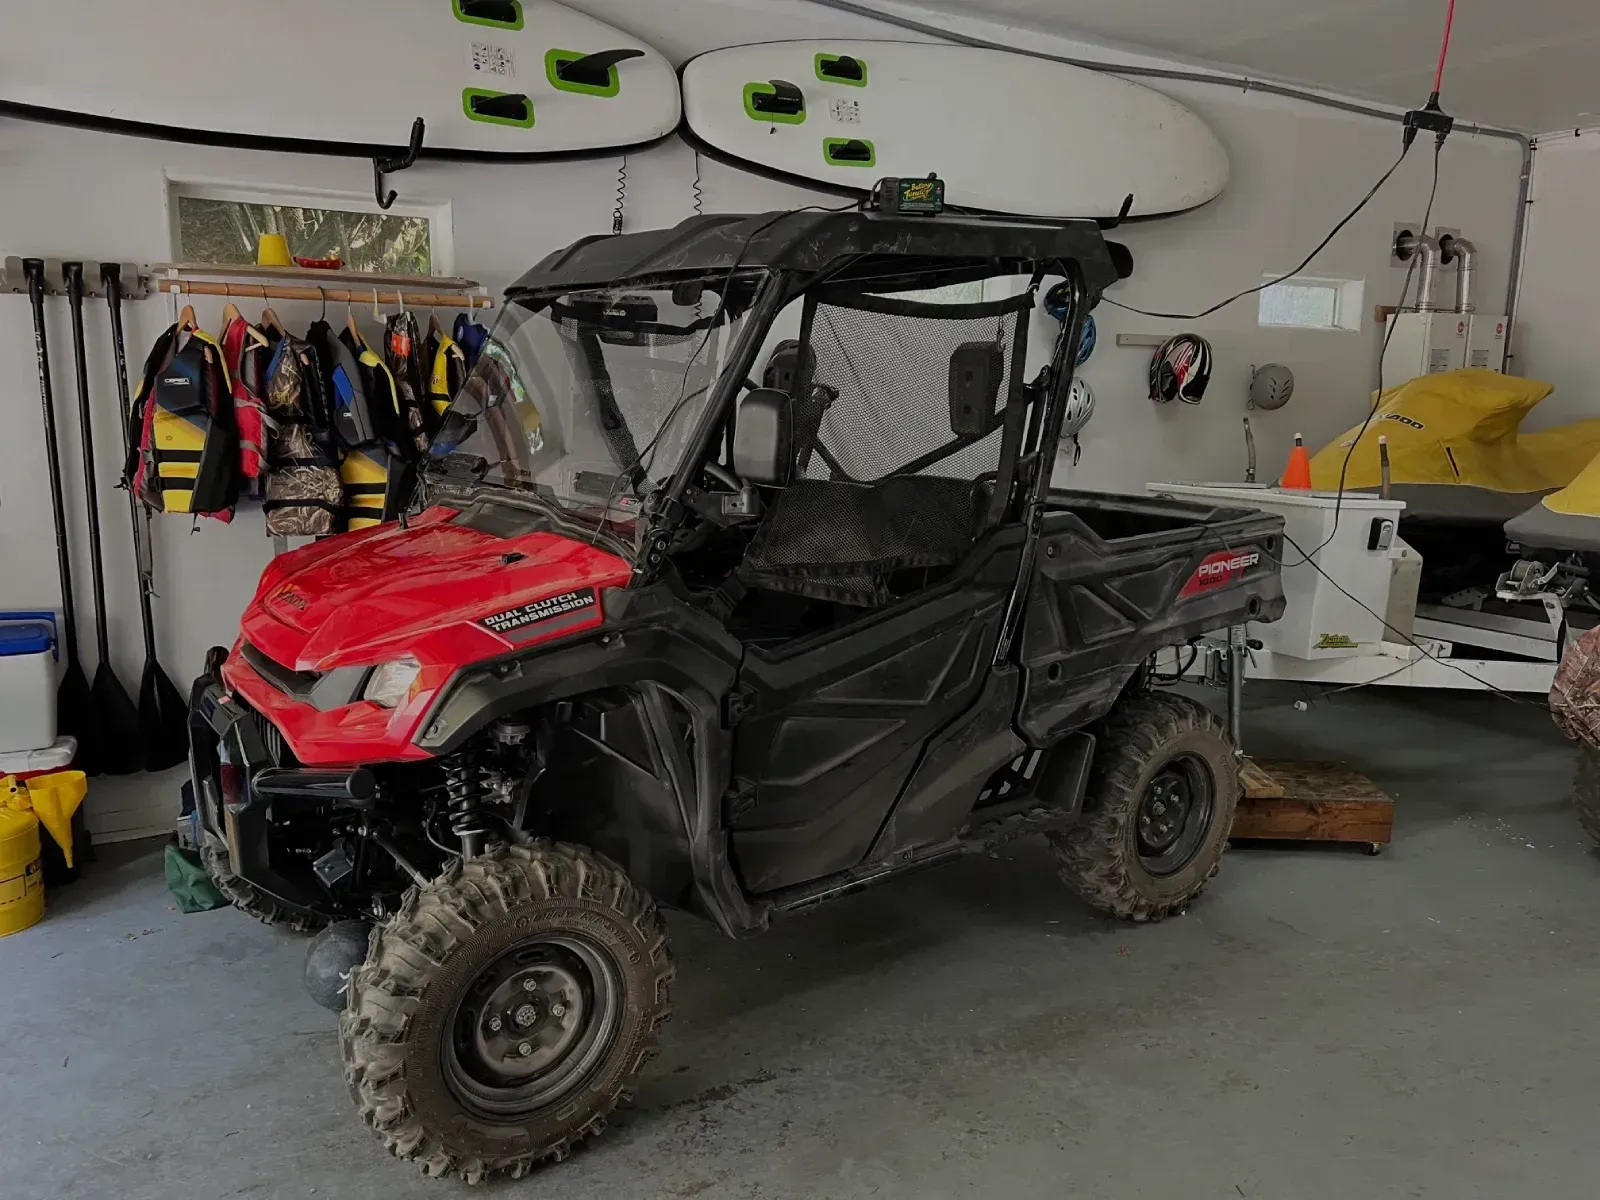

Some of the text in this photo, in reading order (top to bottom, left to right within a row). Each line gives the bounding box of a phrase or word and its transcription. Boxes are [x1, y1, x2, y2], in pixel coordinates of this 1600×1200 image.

[903, 188, 930, 200] Tender
[1198, 553, 1259, 577] PIONEER
[1199, 575, 1224, 587] 1000
[484, 592, 578, 626] DUAL CLUTCH
[491, 595, 594, 632] TRANSMISSION
